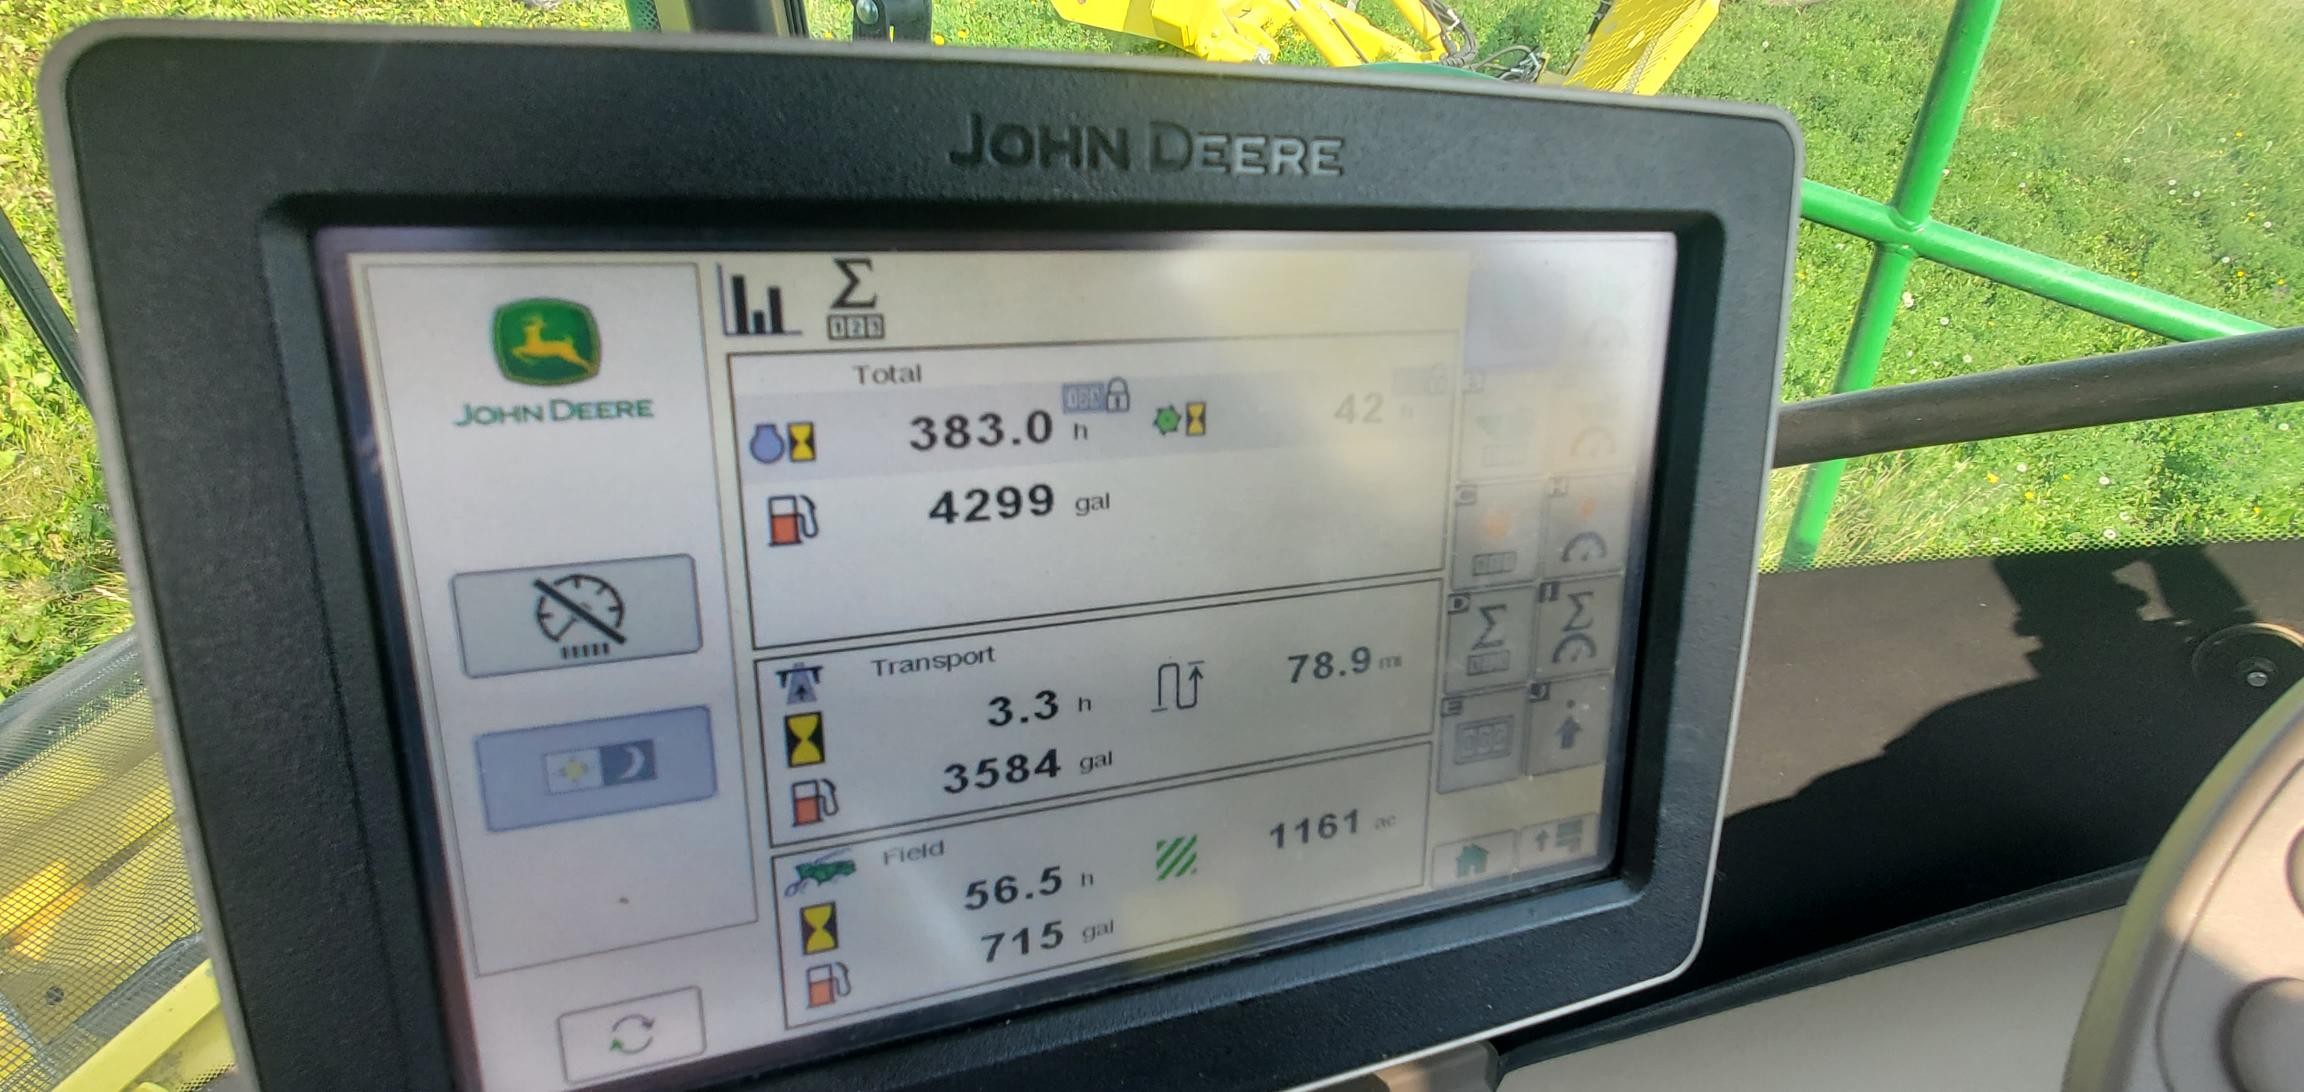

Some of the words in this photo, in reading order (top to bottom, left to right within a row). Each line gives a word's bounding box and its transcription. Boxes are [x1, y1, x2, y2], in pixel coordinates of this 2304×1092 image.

[948, 112, 1131, 172] JOHN
[1148, 119, 1346, 177] DEERE
[852, 364, 923, 385] Total
[454, 402, 545, 427] JOHN
[549, 399, 655, 421] DEERE
[1333, 391, 1385, 425] 42
[909, 409, 1054, 451] 383.0
[1074, 422, 1088, 441] h
[929, 484, 1056, 524] 4299
[1075, 492, 1111, 516] gal
[870, 645, 997, 677] Transport
[1288, 644, 1372, 684] 78.9
[987, 689, 1060, 728] 3.3
[1079, 694, 1093, 713] h
[943, 747, 1062, 795] 3584
[1079, 751, 1114, 775] gal
[1269, 808, 1359, 850] 1161
[882, 839, 946, 866] Field
[964, 865, 1063, 911] 56.5
[1080, 870, 1095, 888] h
[981, 920, 1065, 963] 715
[1082, 919, 1115, 944] gal
